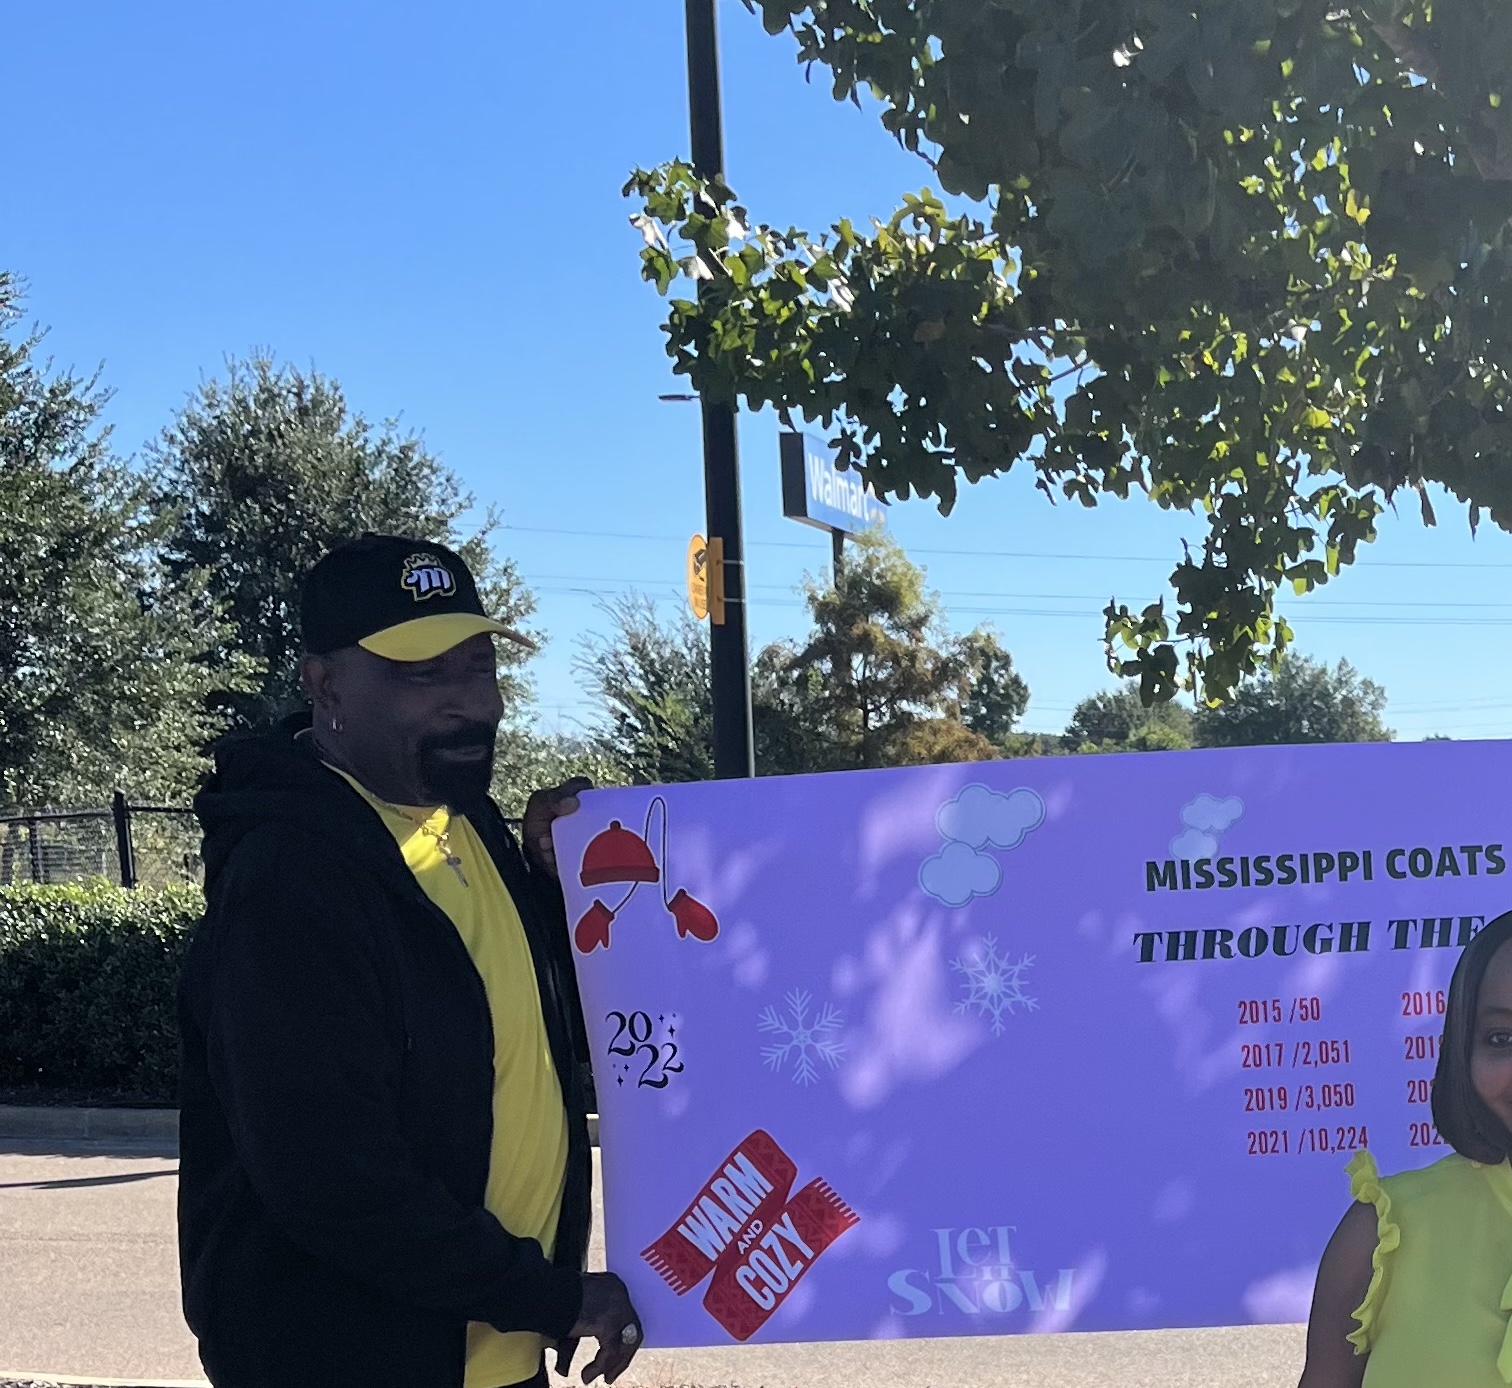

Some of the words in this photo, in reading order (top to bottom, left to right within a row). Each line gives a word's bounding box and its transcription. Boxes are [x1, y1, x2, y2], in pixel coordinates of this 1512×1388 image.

[1146, 850, 1374, 892] MISSISSIPPI
[1386, 844, 1506, 879] COATS
[1133, 920, 1373, 963] THROUGH
[1238, 999, 1282, 1025] 2015
[1289, 997, 1321, 1024] /50
[1402, 990, 1446, 1016] 2016
[1241, 1043, 1283, 1068] 2017
[1292, 1039, 1350, 1068] /2,051
[1244, 1086, 1288, 1112] 2019
[1295, 1082, 1355, 1112] /3,050
[1247, 1130, 1289, 1155] 2021
[1298, 1126, 1368, 1155] /10,224
[676, 1151, 775, 1262] WARM
[736, 1218, 764, 1256] AND
[735, 1211, 815, 1312] COZY
[887, 1268, 1077, 1316] SNOW
